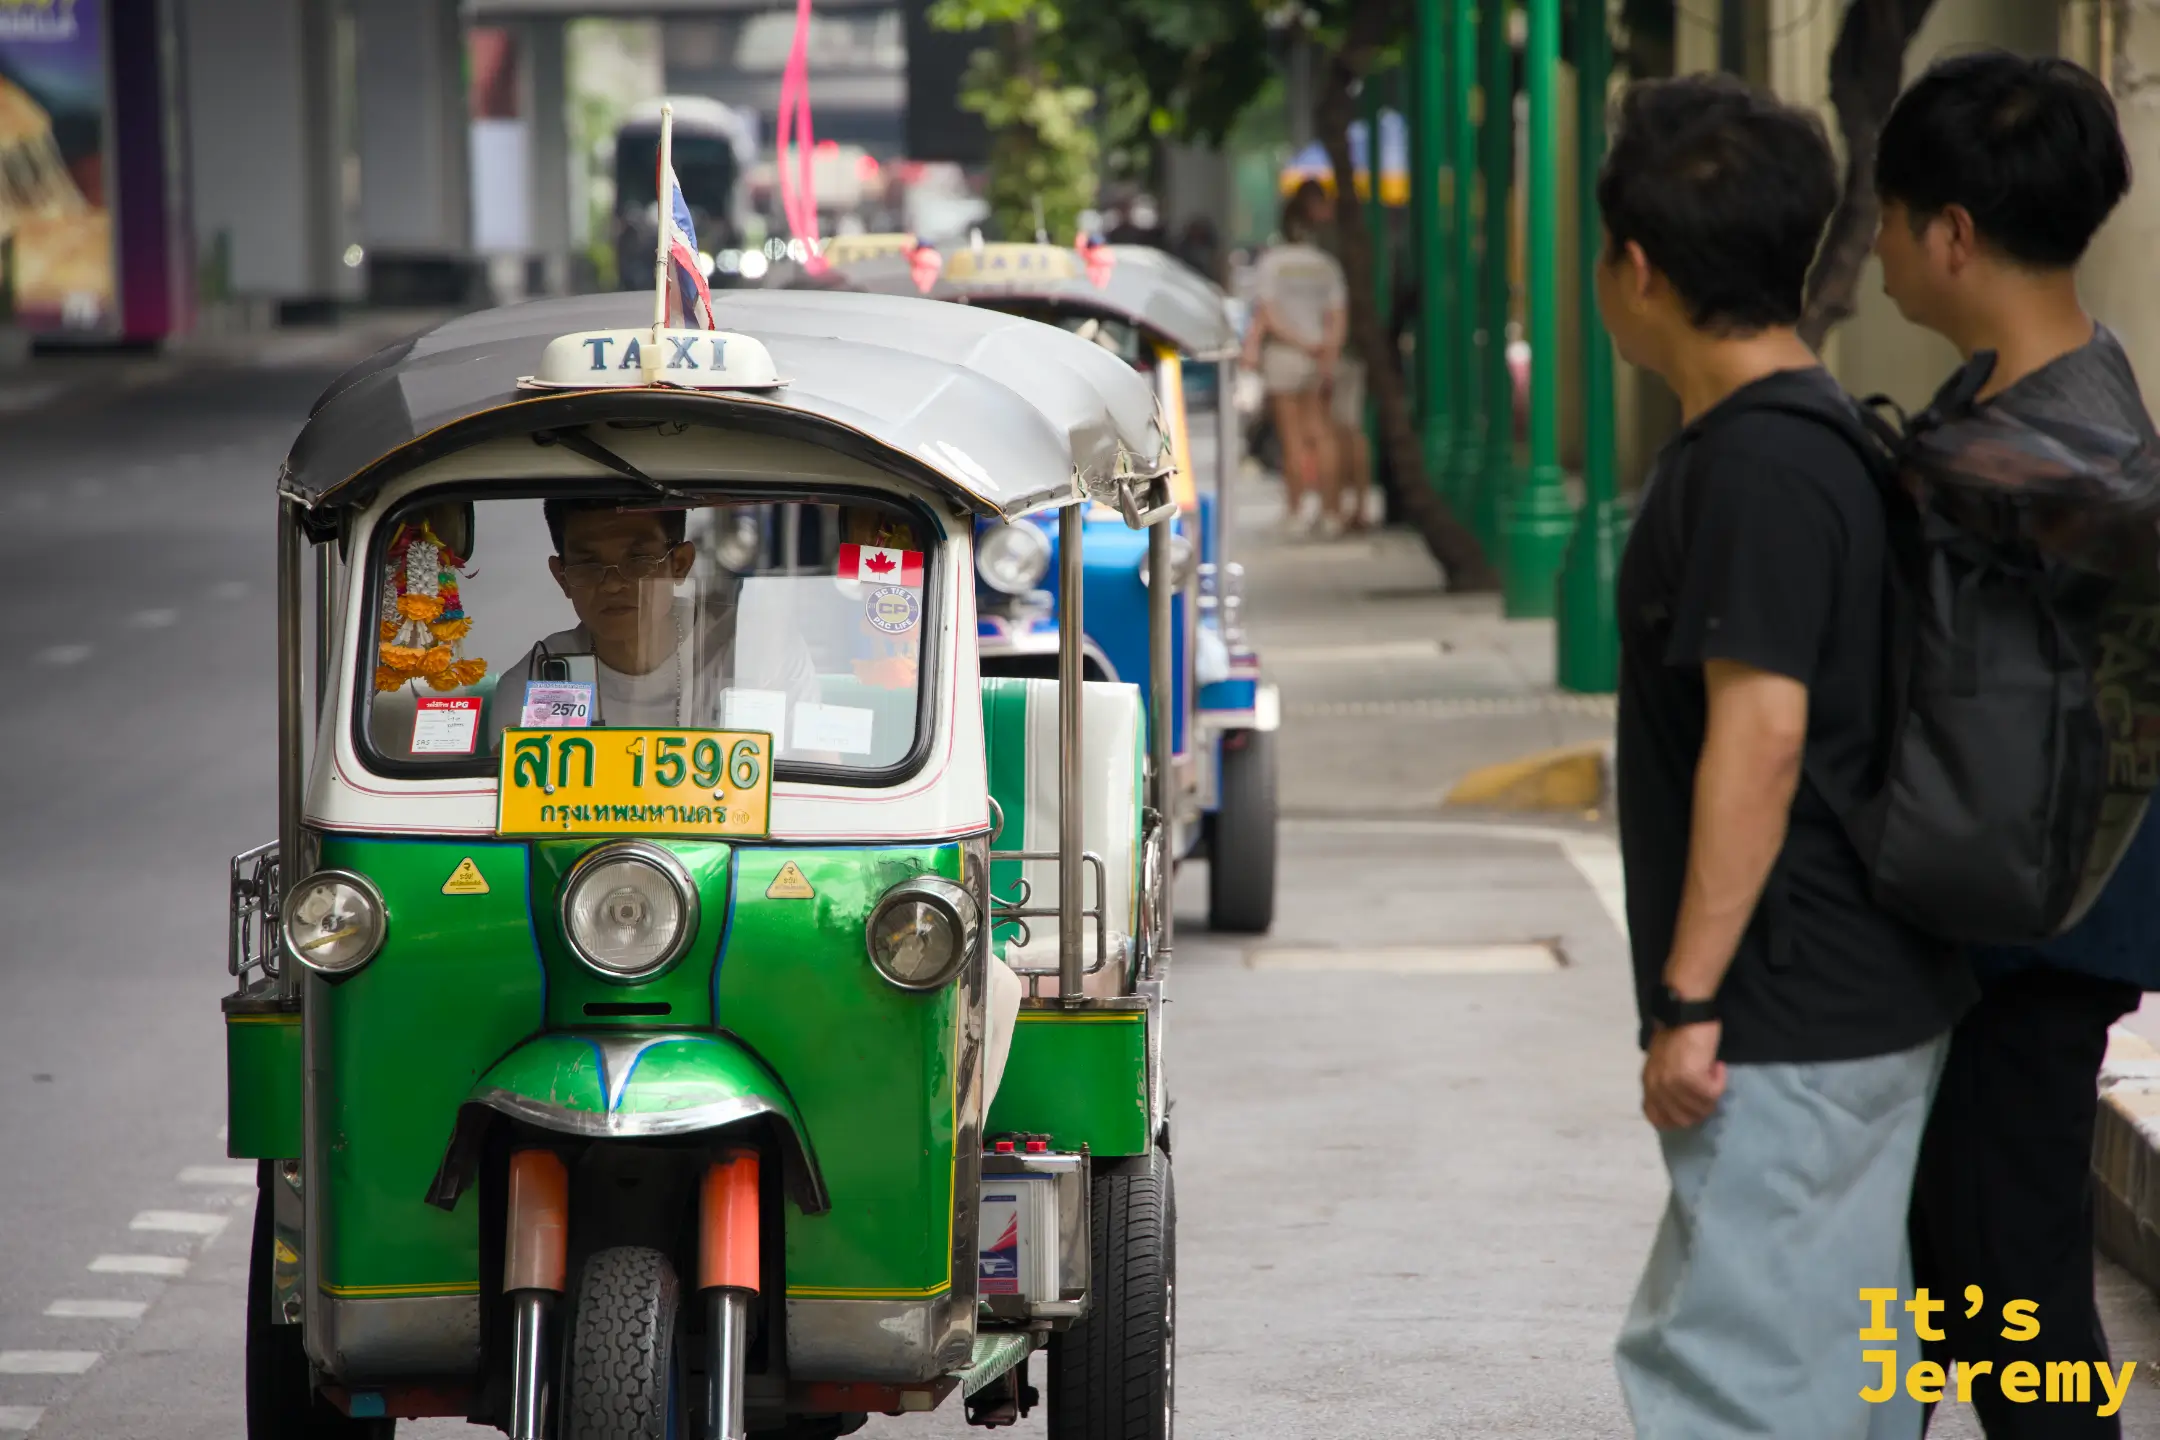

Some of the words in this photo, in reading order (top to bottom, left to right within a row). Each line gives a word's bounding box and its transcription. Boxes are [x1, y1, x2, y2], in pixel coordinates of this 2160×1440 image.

[583, 337, 727, 371] TAXI
[890, 587, 905, 596] TIE
[879, 603, 907, 613] CP
[873, 617, 891, 629] PAC
[894, 619, 913, 630] LIFE
[450, 701, 469, 709] LPG
[551, 703, 586, 717] 2570
[514, 734, 595, 788] สก
[626, 737, 760, 789] 1596
[541, 804, 728, 829] กรุงเทพมหานคร
